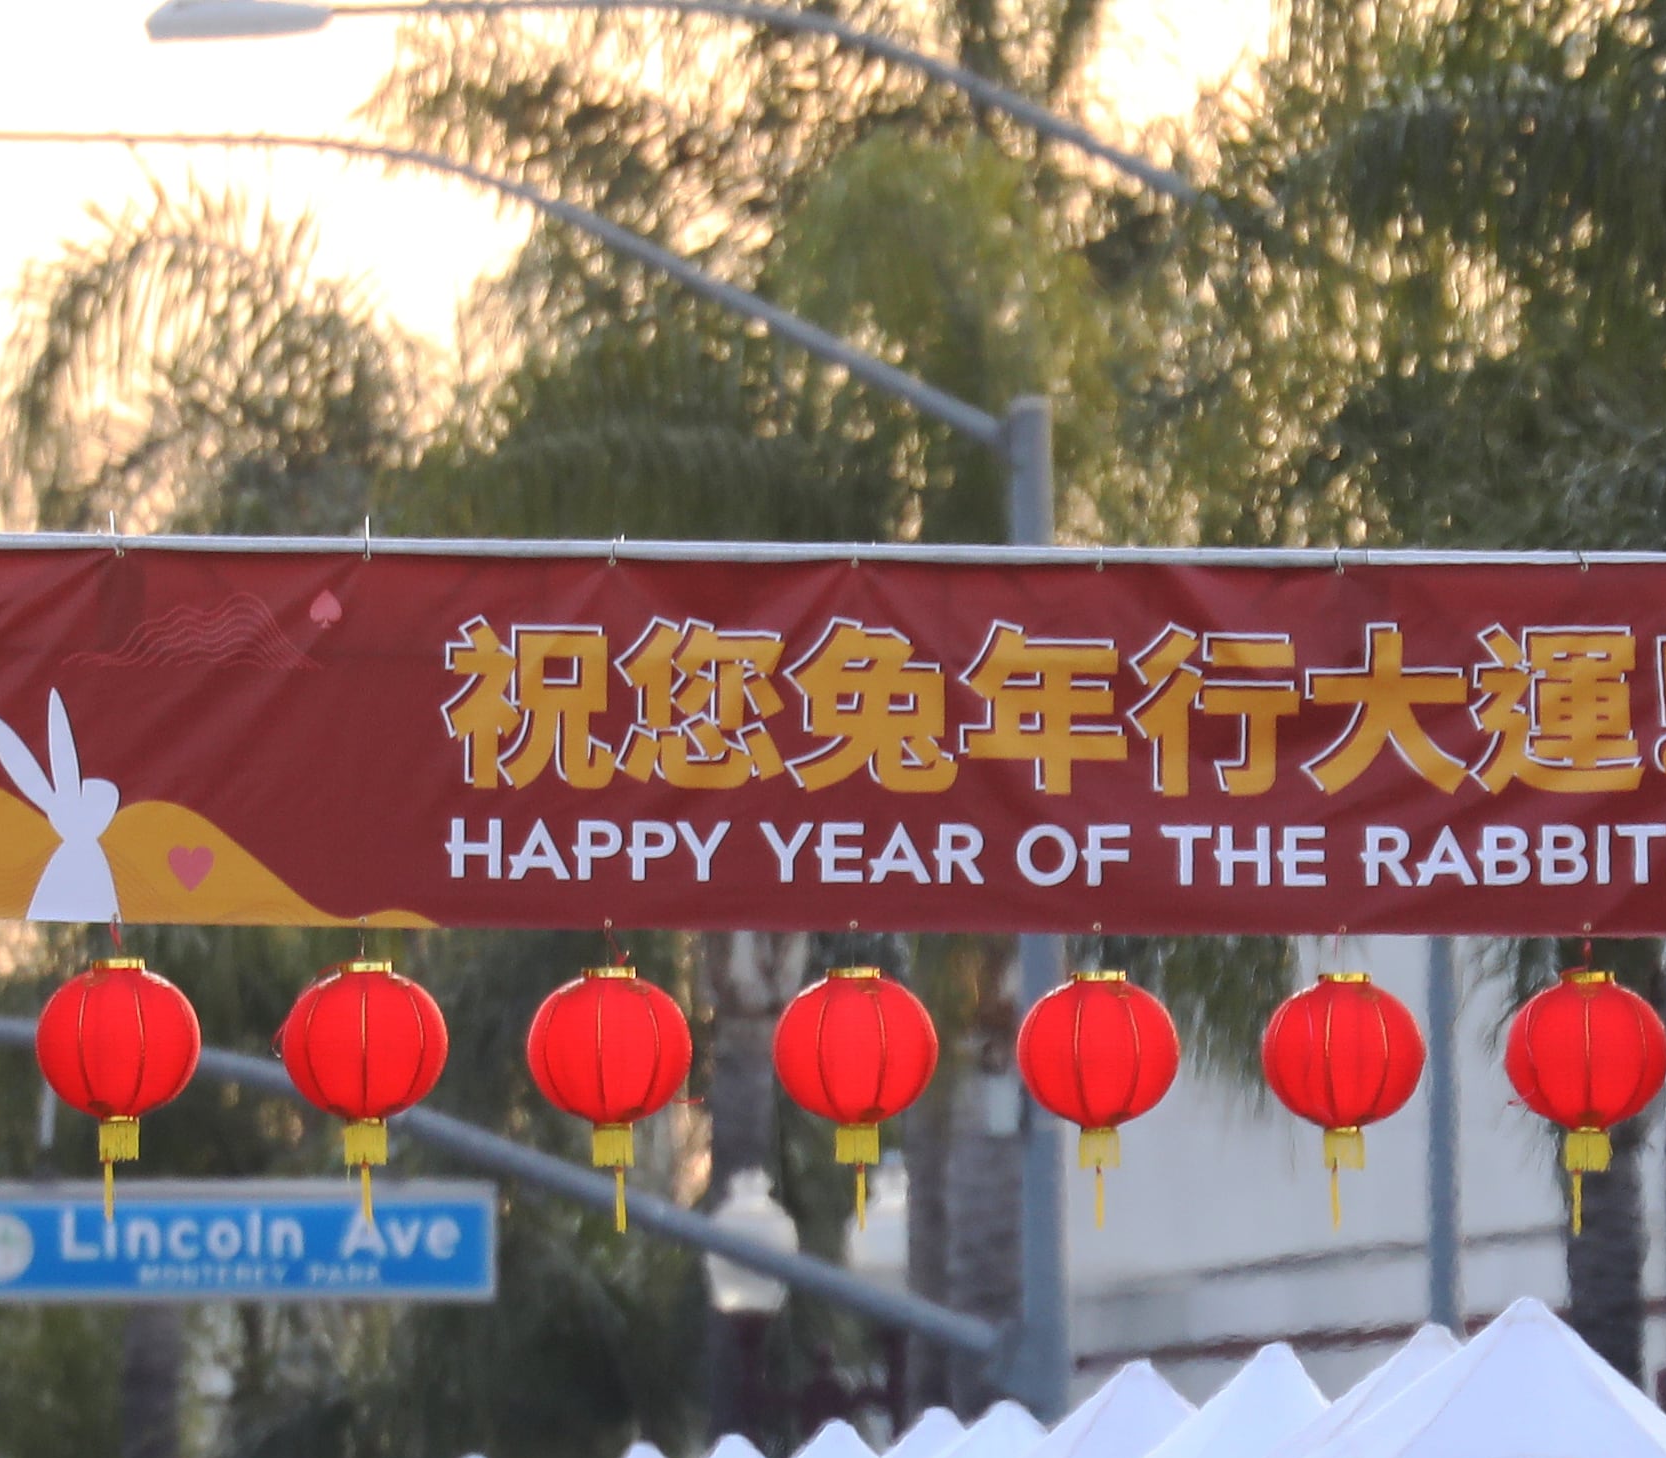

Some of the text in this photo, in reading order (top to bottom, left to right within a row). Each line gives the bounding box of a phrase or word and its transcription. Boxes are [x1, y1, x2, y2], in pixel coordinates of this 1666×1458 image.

[444, 817, 730, 880] HAPPY
[760, 822, 985, 886] YEAR
[1015, 823, 1131, 887] OF
[1161, 825, 1327, 887] THE
[340, 1207, 462, 1260] Ave
